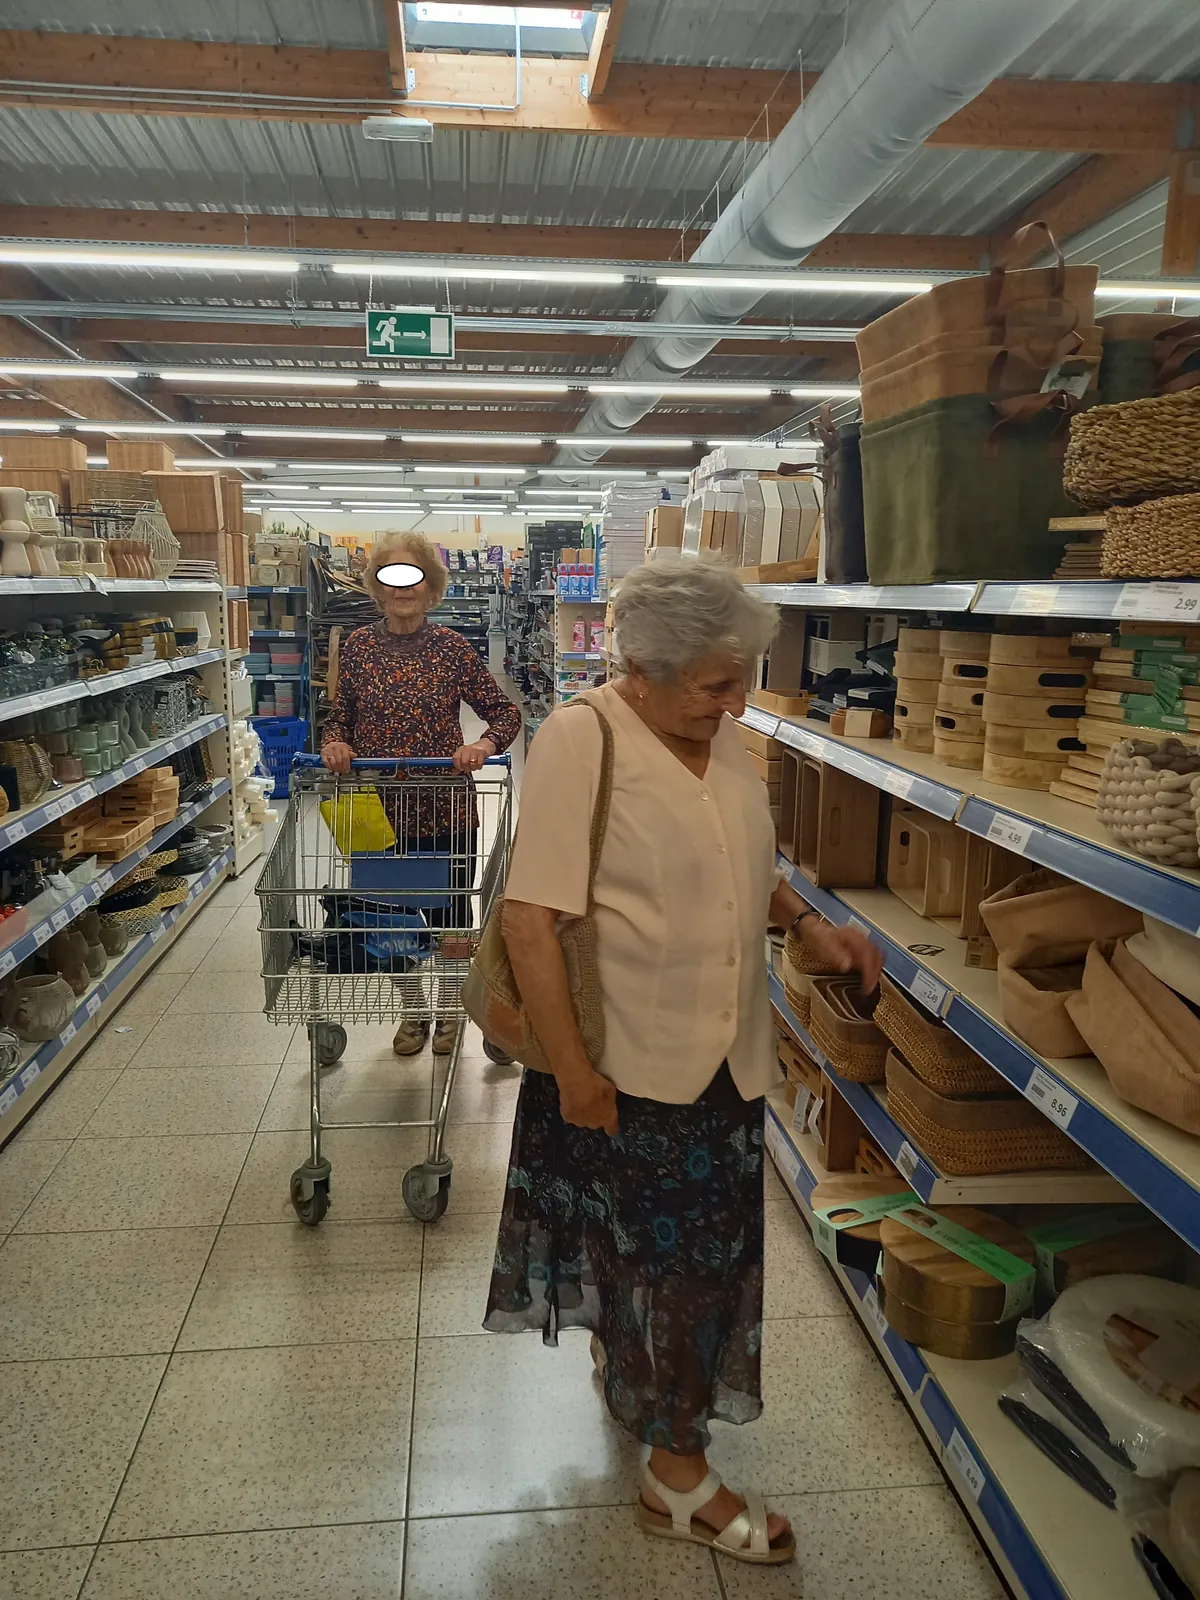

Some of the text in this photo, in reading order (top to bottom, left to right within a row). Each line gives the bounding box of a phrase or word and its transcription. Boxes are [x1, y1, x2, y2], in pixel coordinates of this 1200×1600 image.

[1174, 598, 1197, 610] 2.99
[1007, 831, 1021, 844] 4.99
[1051, 1098, 1068, 1117] 8.96
